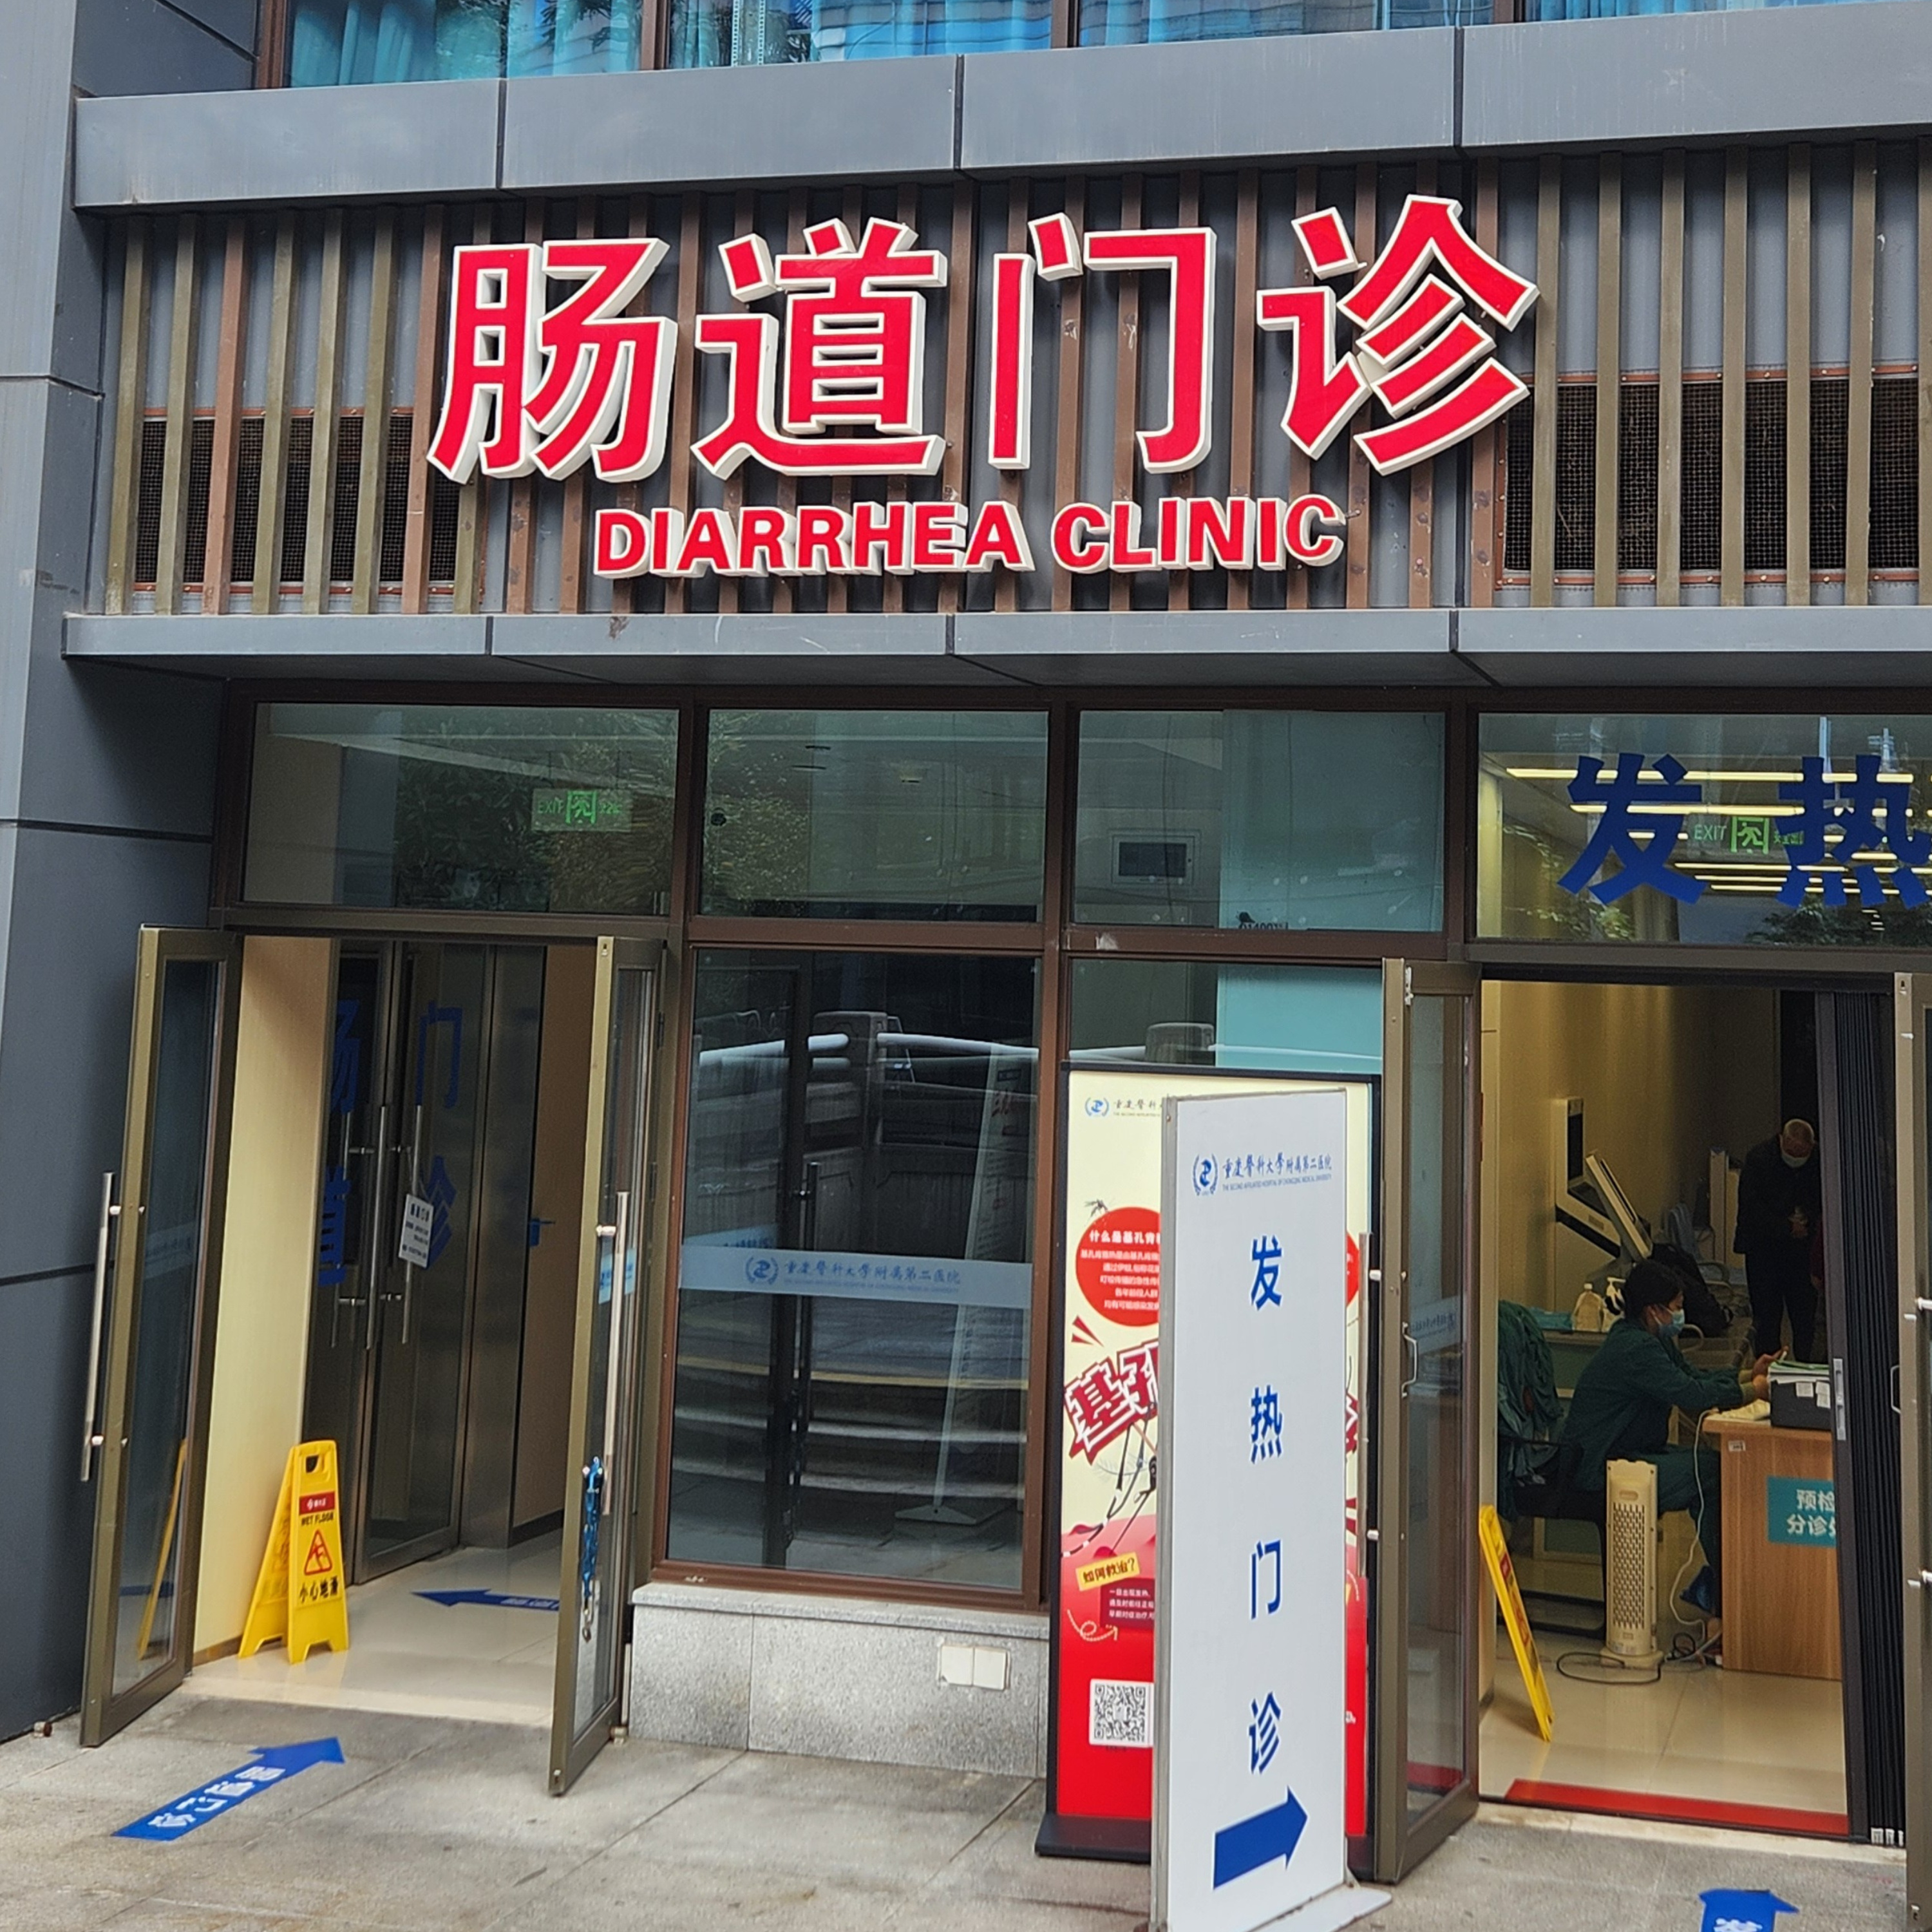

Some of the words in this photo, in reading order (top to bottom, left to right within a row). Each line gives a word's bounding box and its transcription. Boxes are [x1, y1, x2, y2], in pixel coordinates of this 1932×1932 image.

[427, 194, 1539, 484] 肠道门诊
[593, 501, 1035, 578] DIARRHEA
[1051, 494, 1345, 574] CLINIC
[1557, 753, 1932, 909] 发热
[1694, 824, 1727, 841] EXIT
[1248, 1235, 1283, 1775] 发热门诊
[1795, 1488, 1835, 1513] 预检
[299, 1575, 338, 1604] 小心地滑
